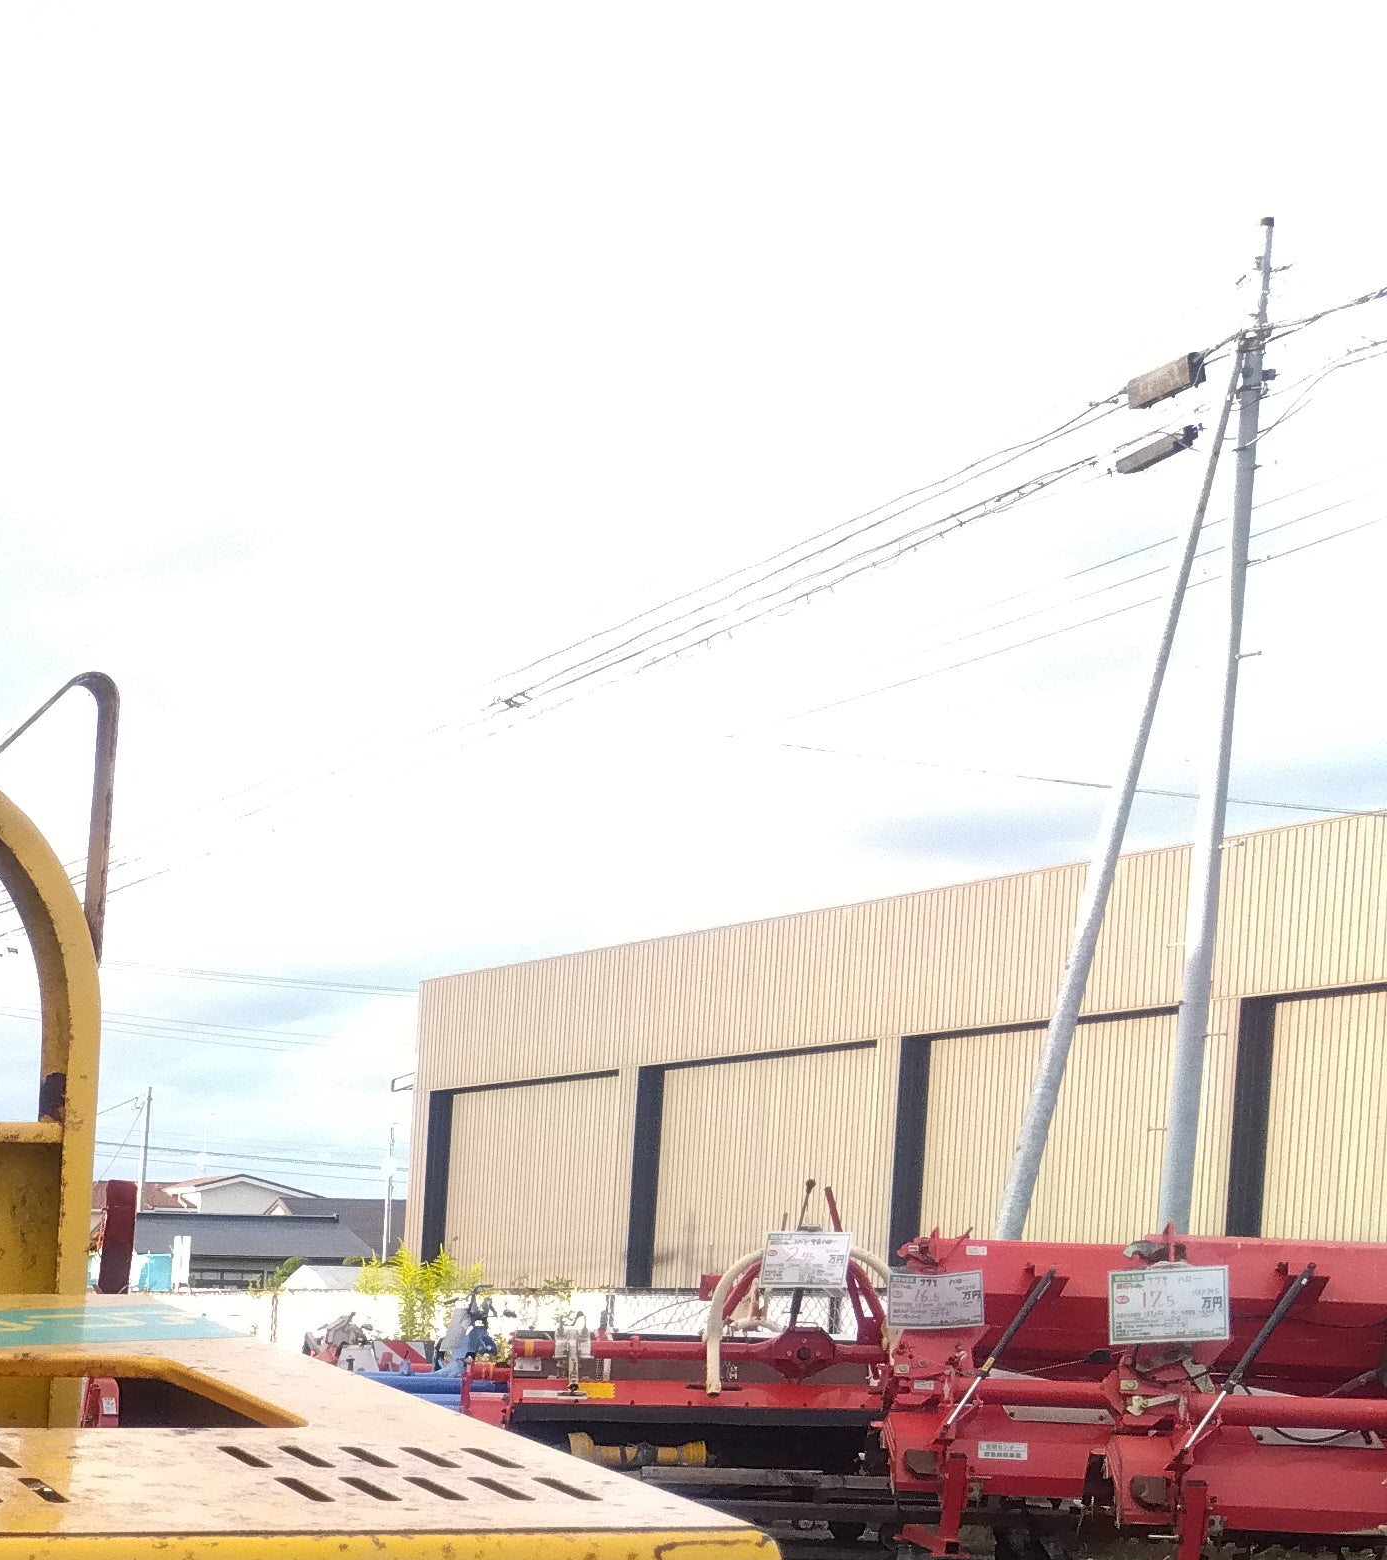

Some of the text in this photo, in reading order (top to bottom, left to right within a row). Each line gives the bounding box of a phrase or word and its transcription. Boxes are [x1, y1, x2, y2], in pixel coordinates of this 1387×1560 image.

[829, 1255, 845, 1264] 万円
[962, 1289, 982, 1301] 万円
[1201, 1296, 1223, 1309] 万円
